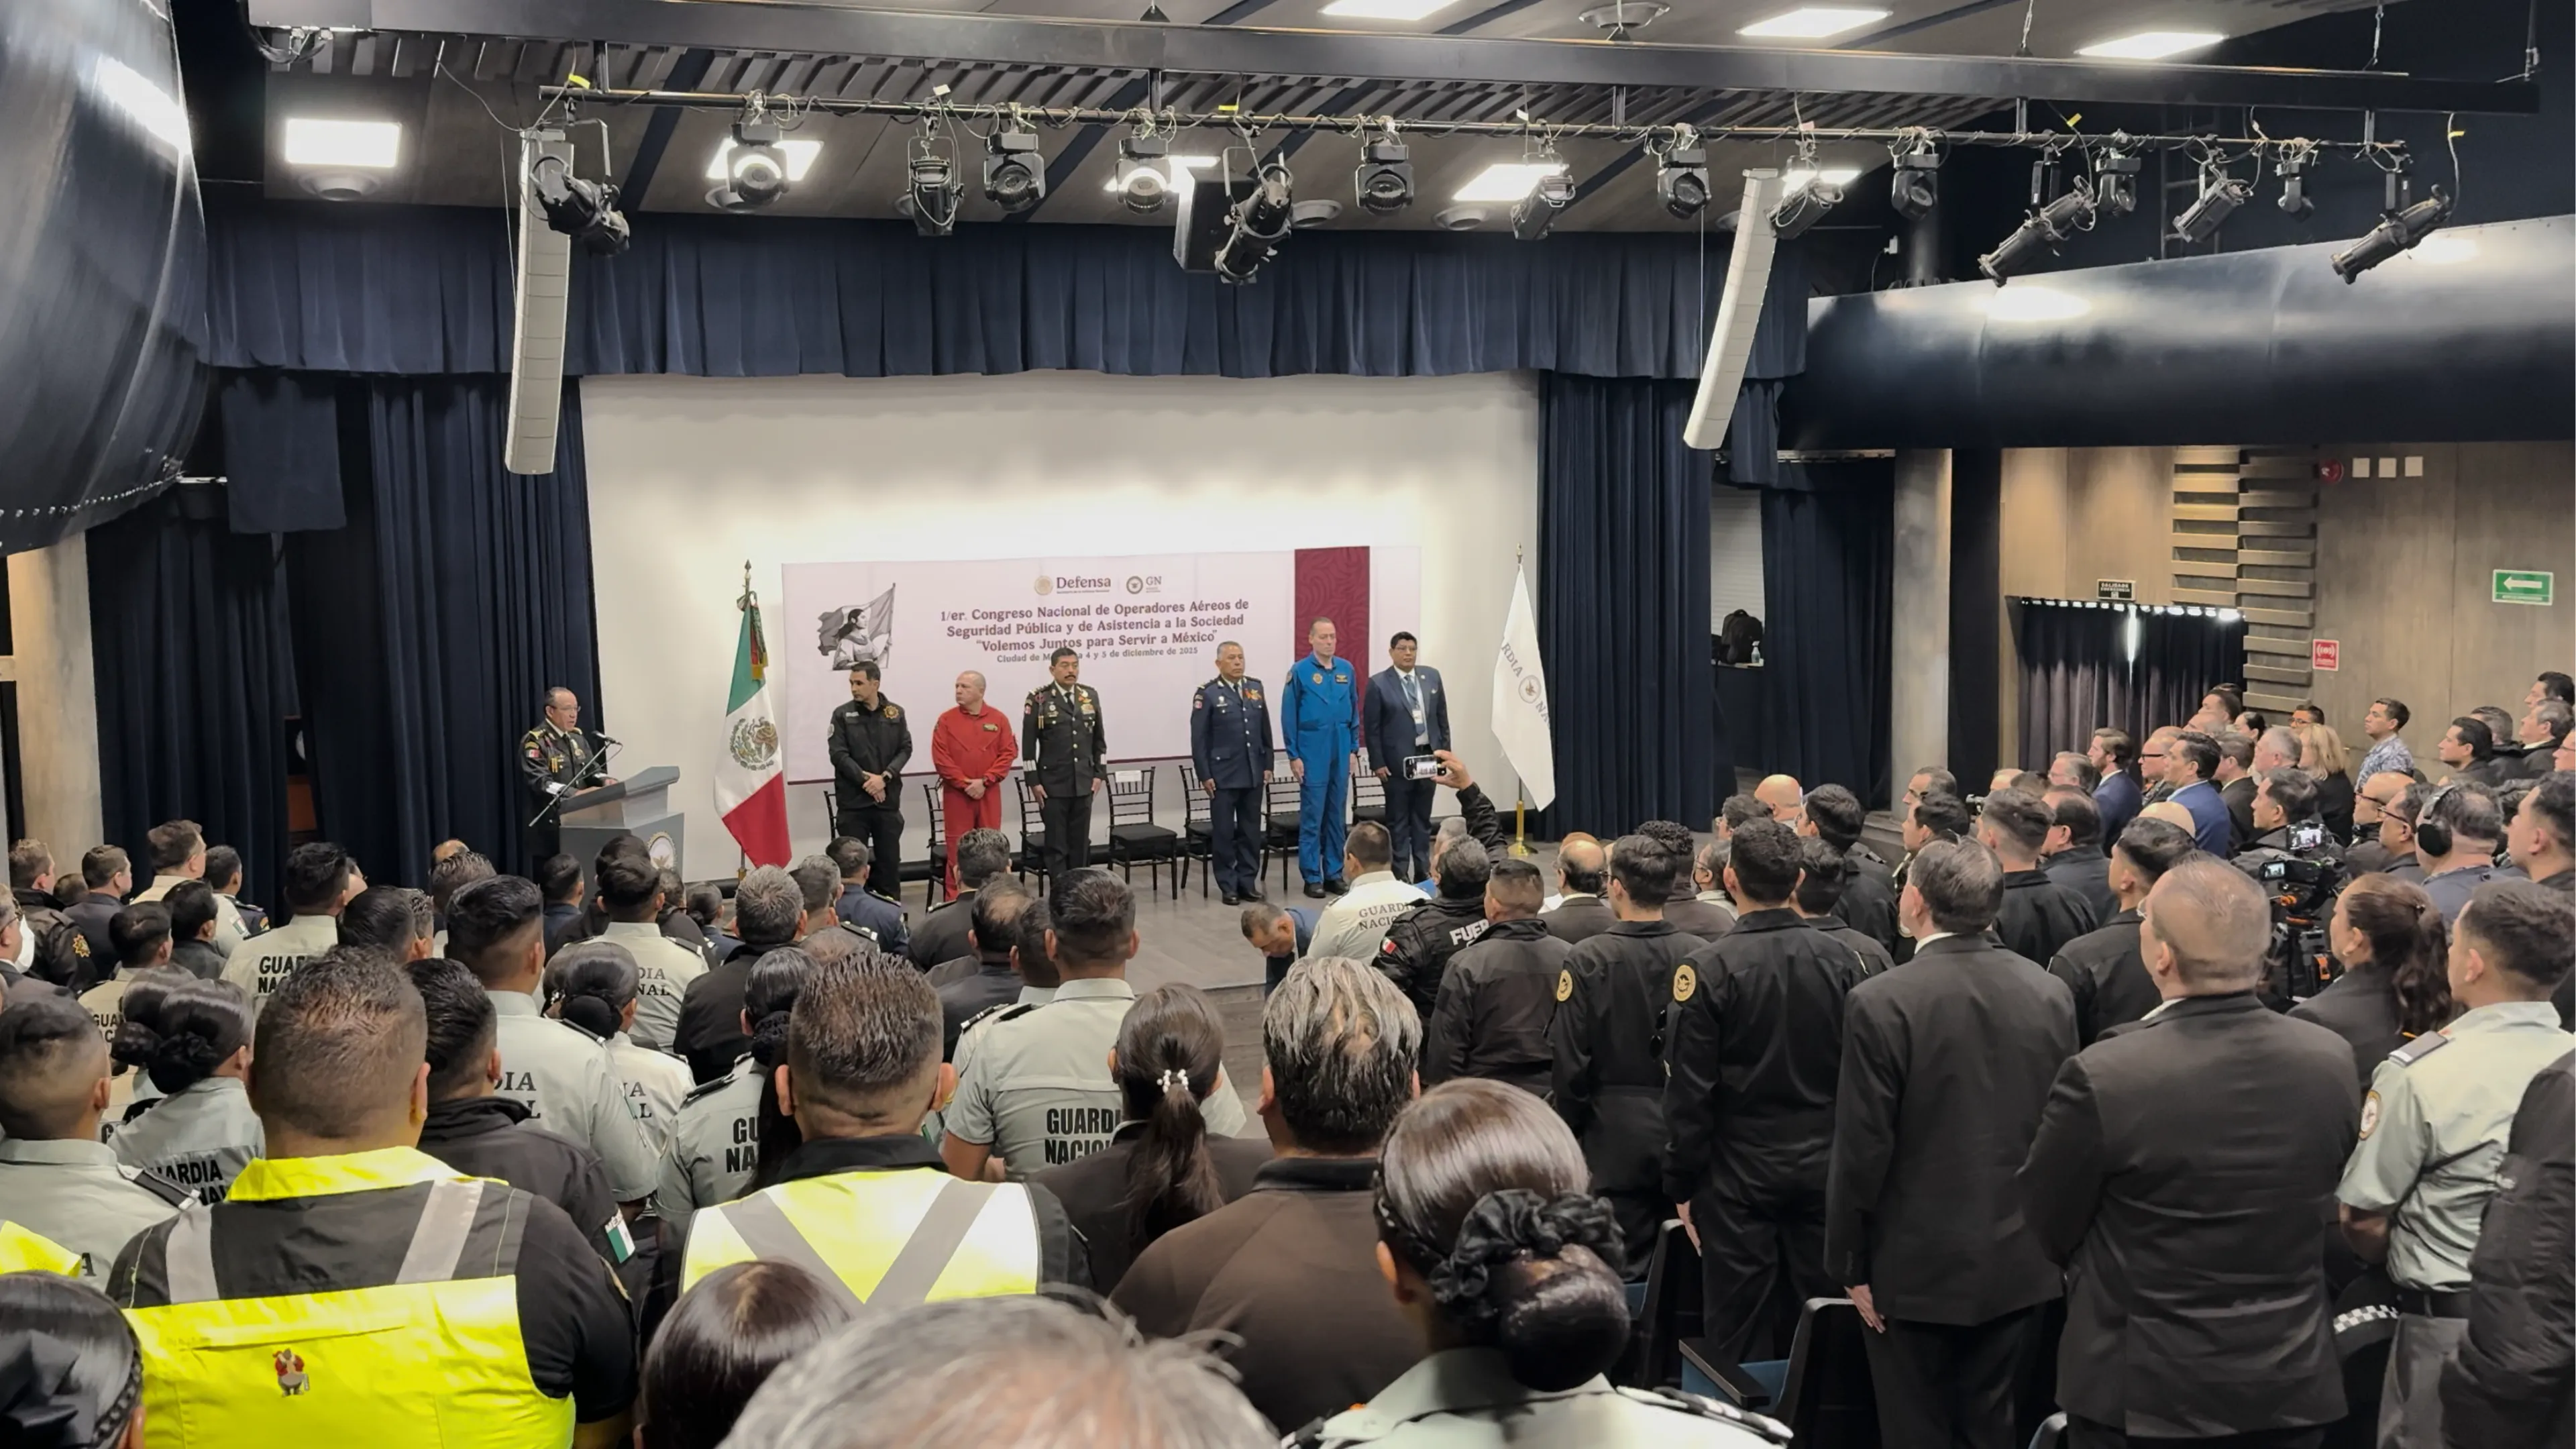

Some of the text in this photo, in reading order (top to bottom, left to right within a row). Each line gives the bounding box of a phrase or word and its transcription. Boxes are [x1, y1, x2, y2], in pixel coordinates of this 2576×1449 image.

[1057, 576, 1111, 589] Defensa
[1146, 576, 1162, 586] GN
[972, 608, 1033, 623] Congreso
[1037, 604, 1091, 618] Nacional
[1095, 604, 1110, 615] de
[1114, 602, 1185, 616] Operadores
[1189, 600, 1231, 612] Aéreos
[1235, 599, 1249, 610] de
[947, 614, 1244, 639] Seguridad Pública y de Asistencia a la Sociedad
[1039, 638, 1082, 649] Juntos
[1087, 637, 1114, 649] para
[1118, 634, 1157, 646] Servir
[1161, 636, 1167, 644] a
[997, 653, 1027, 663] Ciudad
[1029, 653, 1040, 661] de
[1093, 652, 1099, 660] y
[1110, 649, 1120, 657] de
[1122, 648, 1164, 657] diciembre
[1167, 647, 1177, 655] de
[1179, 647, 1198, 655] 2025
[1044, 1139, 1110, 1165] NACIO
